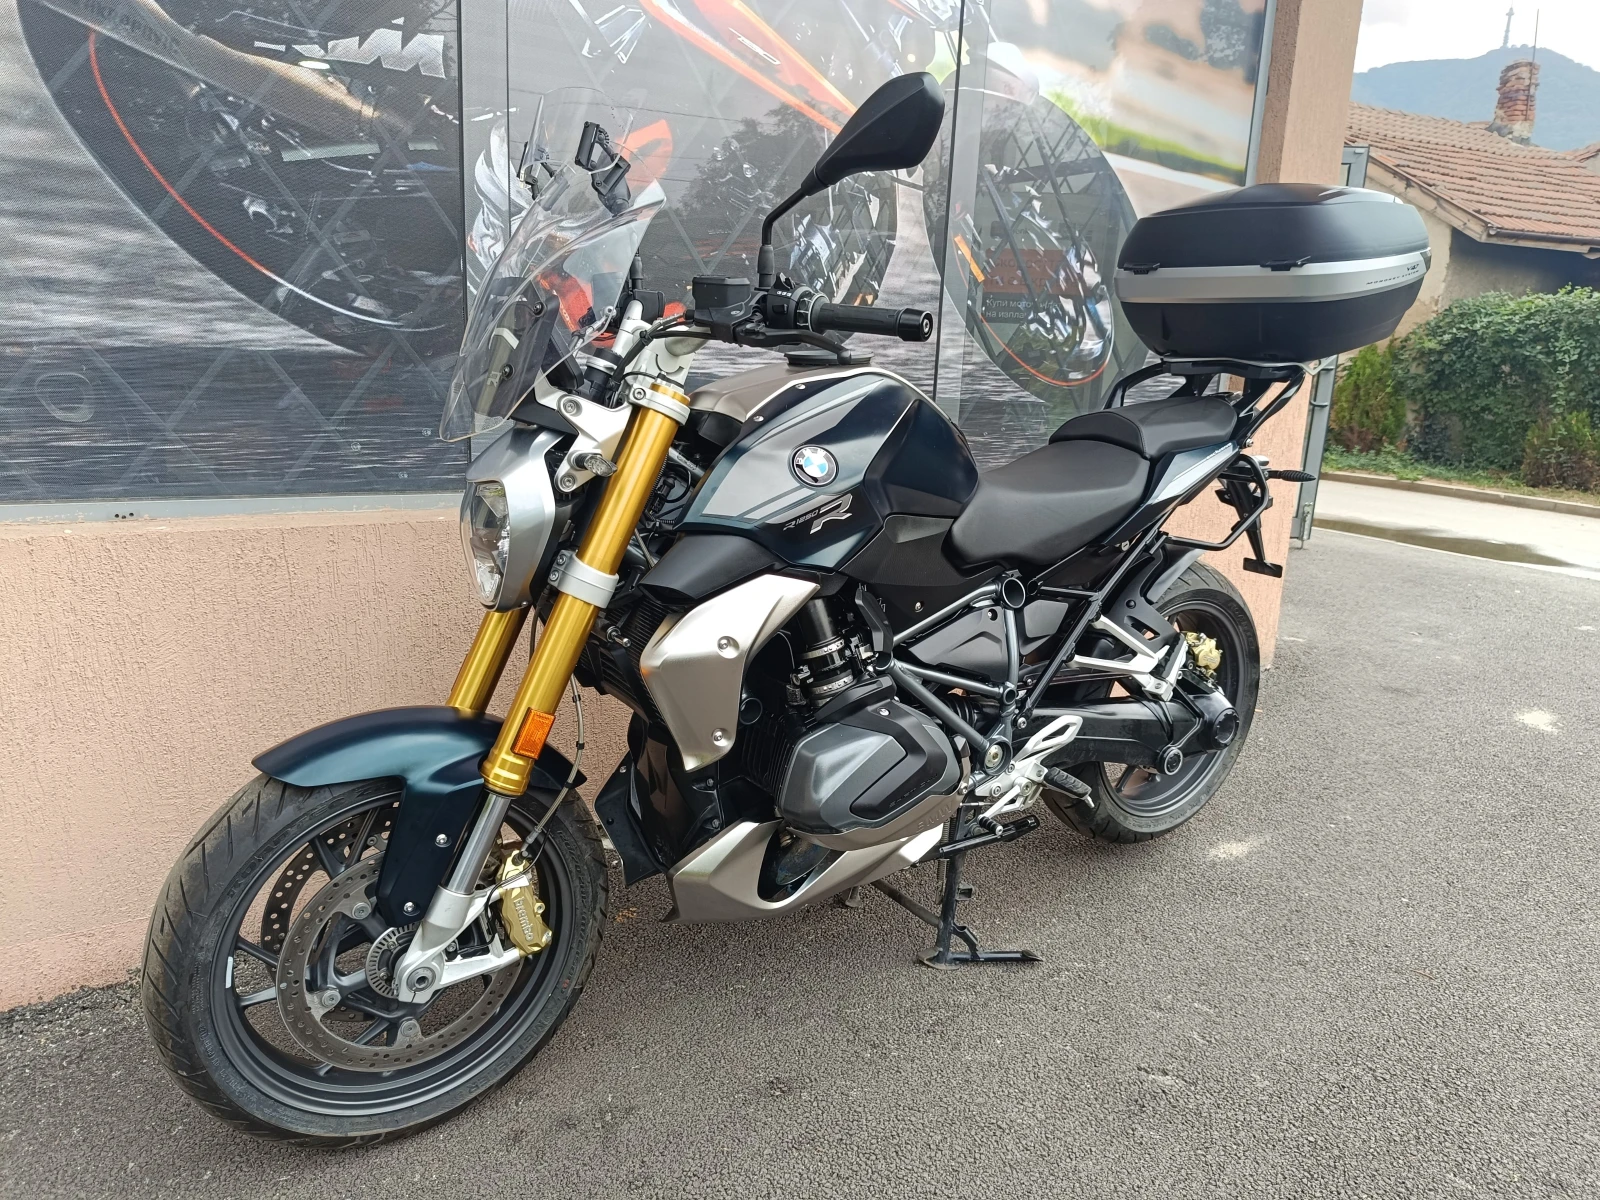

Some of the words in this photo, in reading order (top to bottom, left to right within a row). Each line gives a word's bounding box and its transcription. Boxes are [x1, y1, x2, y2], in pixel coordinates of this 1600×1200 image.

[986, 298, 1008, 308] Купи
[986, 311, 997, 319] на
[810, 493, 853, 535] R
[513, 896, 534, 942] brembo
